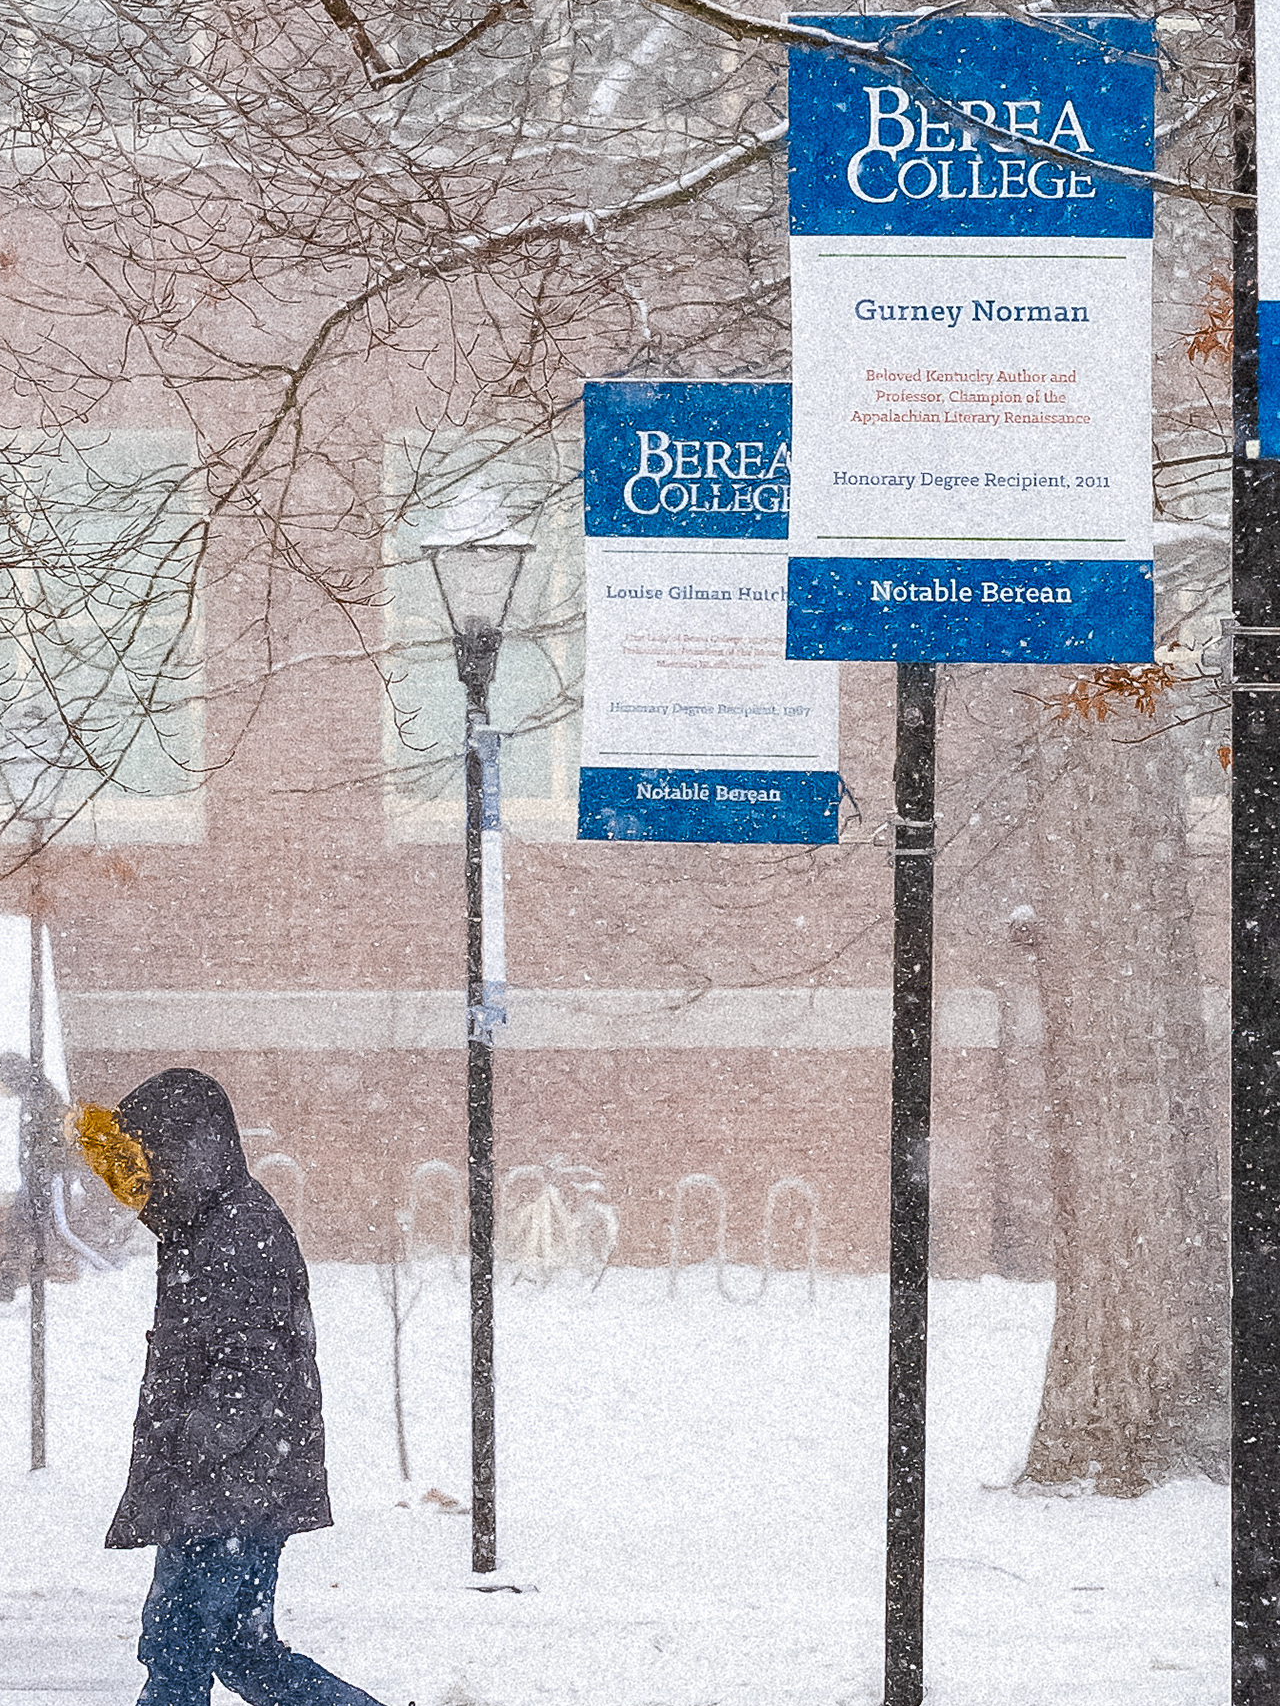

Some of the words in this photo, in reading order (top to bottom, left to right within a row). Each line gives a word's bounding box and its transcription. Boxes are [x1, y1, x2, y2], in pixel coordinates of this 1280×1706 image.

[863, 86, 1094, 152] BEREA
[847, 147, 1096, 203] COLLEGE
[854, 299, 962, 327] Gurney
[972, 300, 1089, 322] Norman
[866, 368, 921, 382] Beloved
[926, 370, 993, 385] Kentucky
[996, 370, 1046, 383] Author
[1050, 370, 1076, 383] and
[876, 389, 945, 404] Professor,
[949, 390, 1022, 405] Champion
[1026, 389, 1040, 403] of
[1044, 390, 1066, 403] the
[851, 410, 940, 425] Appalachian
[944, 411, 1000, 426] Literary
[1004, 412, 1091, 424] Renaissance
[833, 471, 915, 489] Honorary
[920, 472, 979, 490] Degree
[984, 473, 1070, 491] Recipient,
[1075, 477, 1110, 488] 2011
[606, 585, 662, 600] Louise
[669, 586, 732, 600] Gilman
[871, 580, 972, 603] Notable
[980, 582, 1072, 603] Berean
[636, 784, 709, 800] Notable
[716, 785, 781, 802] Berean
